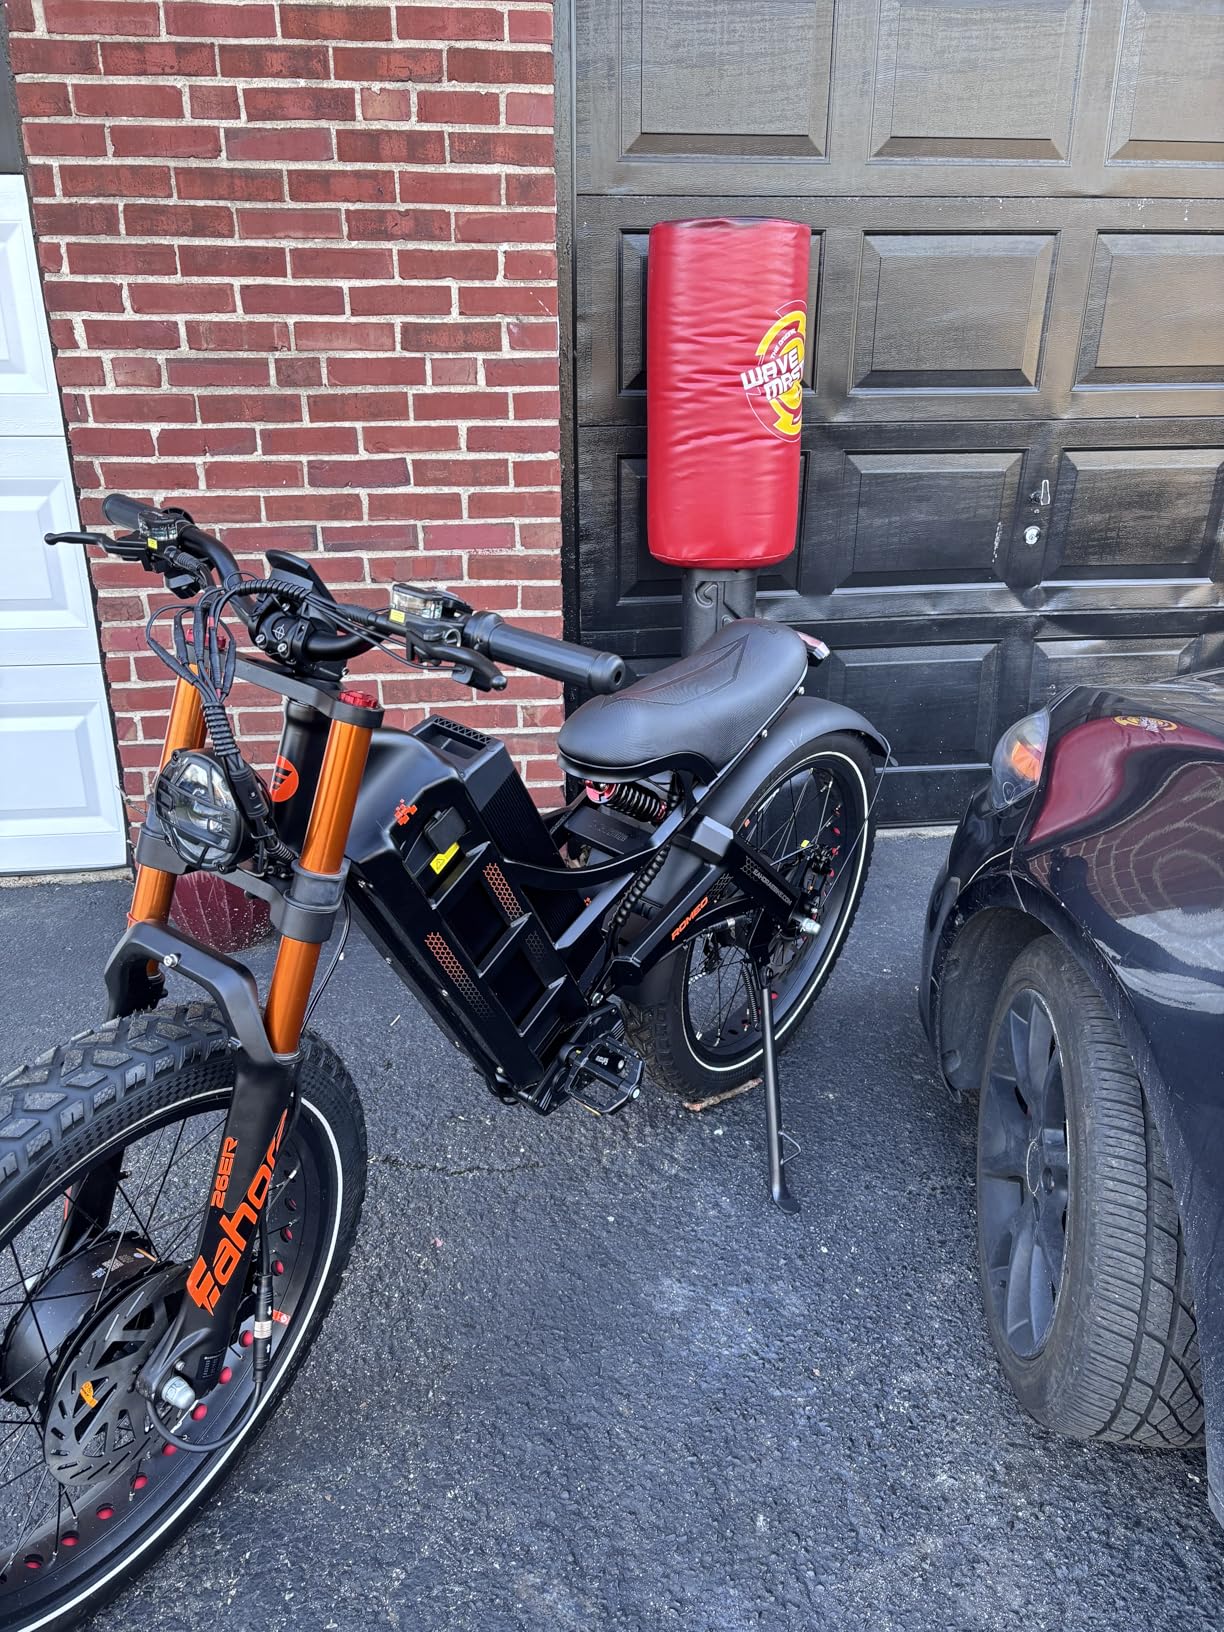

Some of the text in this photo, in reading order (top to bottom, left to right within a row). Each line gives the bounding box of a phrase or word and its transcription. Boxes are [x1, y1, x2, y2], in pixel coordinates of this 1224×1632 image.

[740, 348, 799, 390] WAVE
[671, 896, 709, 941] ROMEO
[211, 1136, 238, 1209] 26ER
